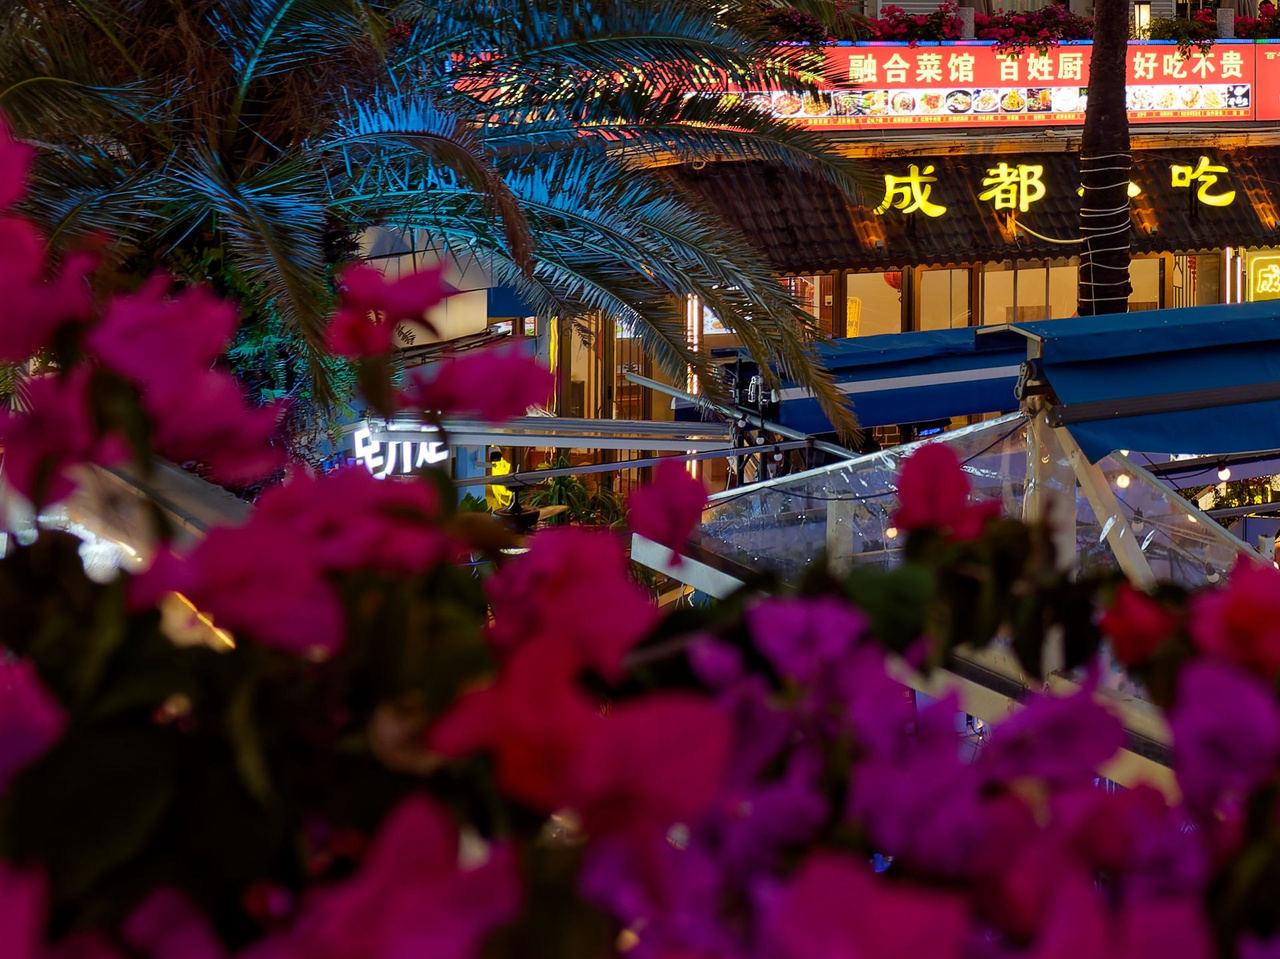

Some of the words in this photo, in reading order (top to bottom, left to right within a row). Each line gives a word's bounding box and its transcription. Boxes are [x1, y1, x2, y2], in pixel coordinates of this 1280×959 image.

[848, 52, 976, 83] 融合菜馆
[996, 52, 1089, 81] 百姓厨
[1133, 50, 1244, 80] 好吃不贵
[873, 155, 1236, 218] 成都吃
